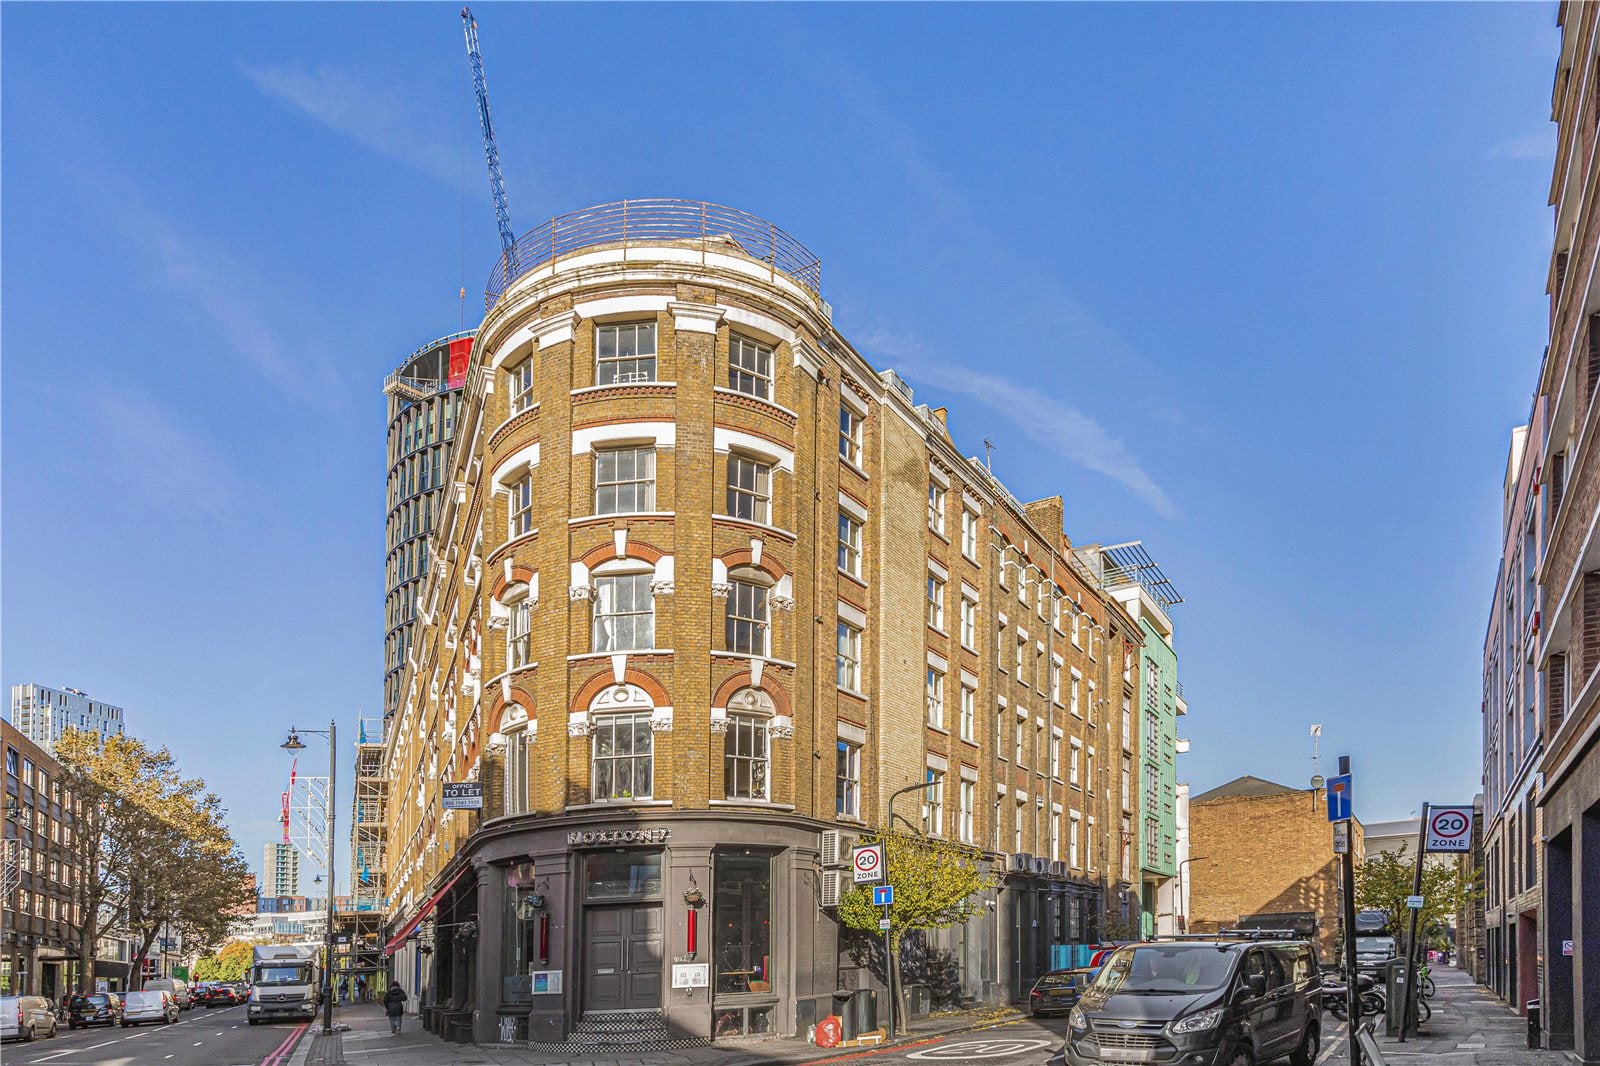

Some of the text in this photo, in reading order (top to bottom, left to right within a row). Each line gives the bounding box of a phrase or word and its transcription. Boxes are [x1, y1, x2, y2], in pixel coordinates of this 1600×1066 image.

[444, 788, 481, 797] TO LET
[1438, 819, 1463, 830] 20
[1431, 839, 1465, 847] ZONE
[859, 855, 875, 866] 20
[857, 871, 878, 879] ZONE
[932, 1044, 1024, 1053] 20
